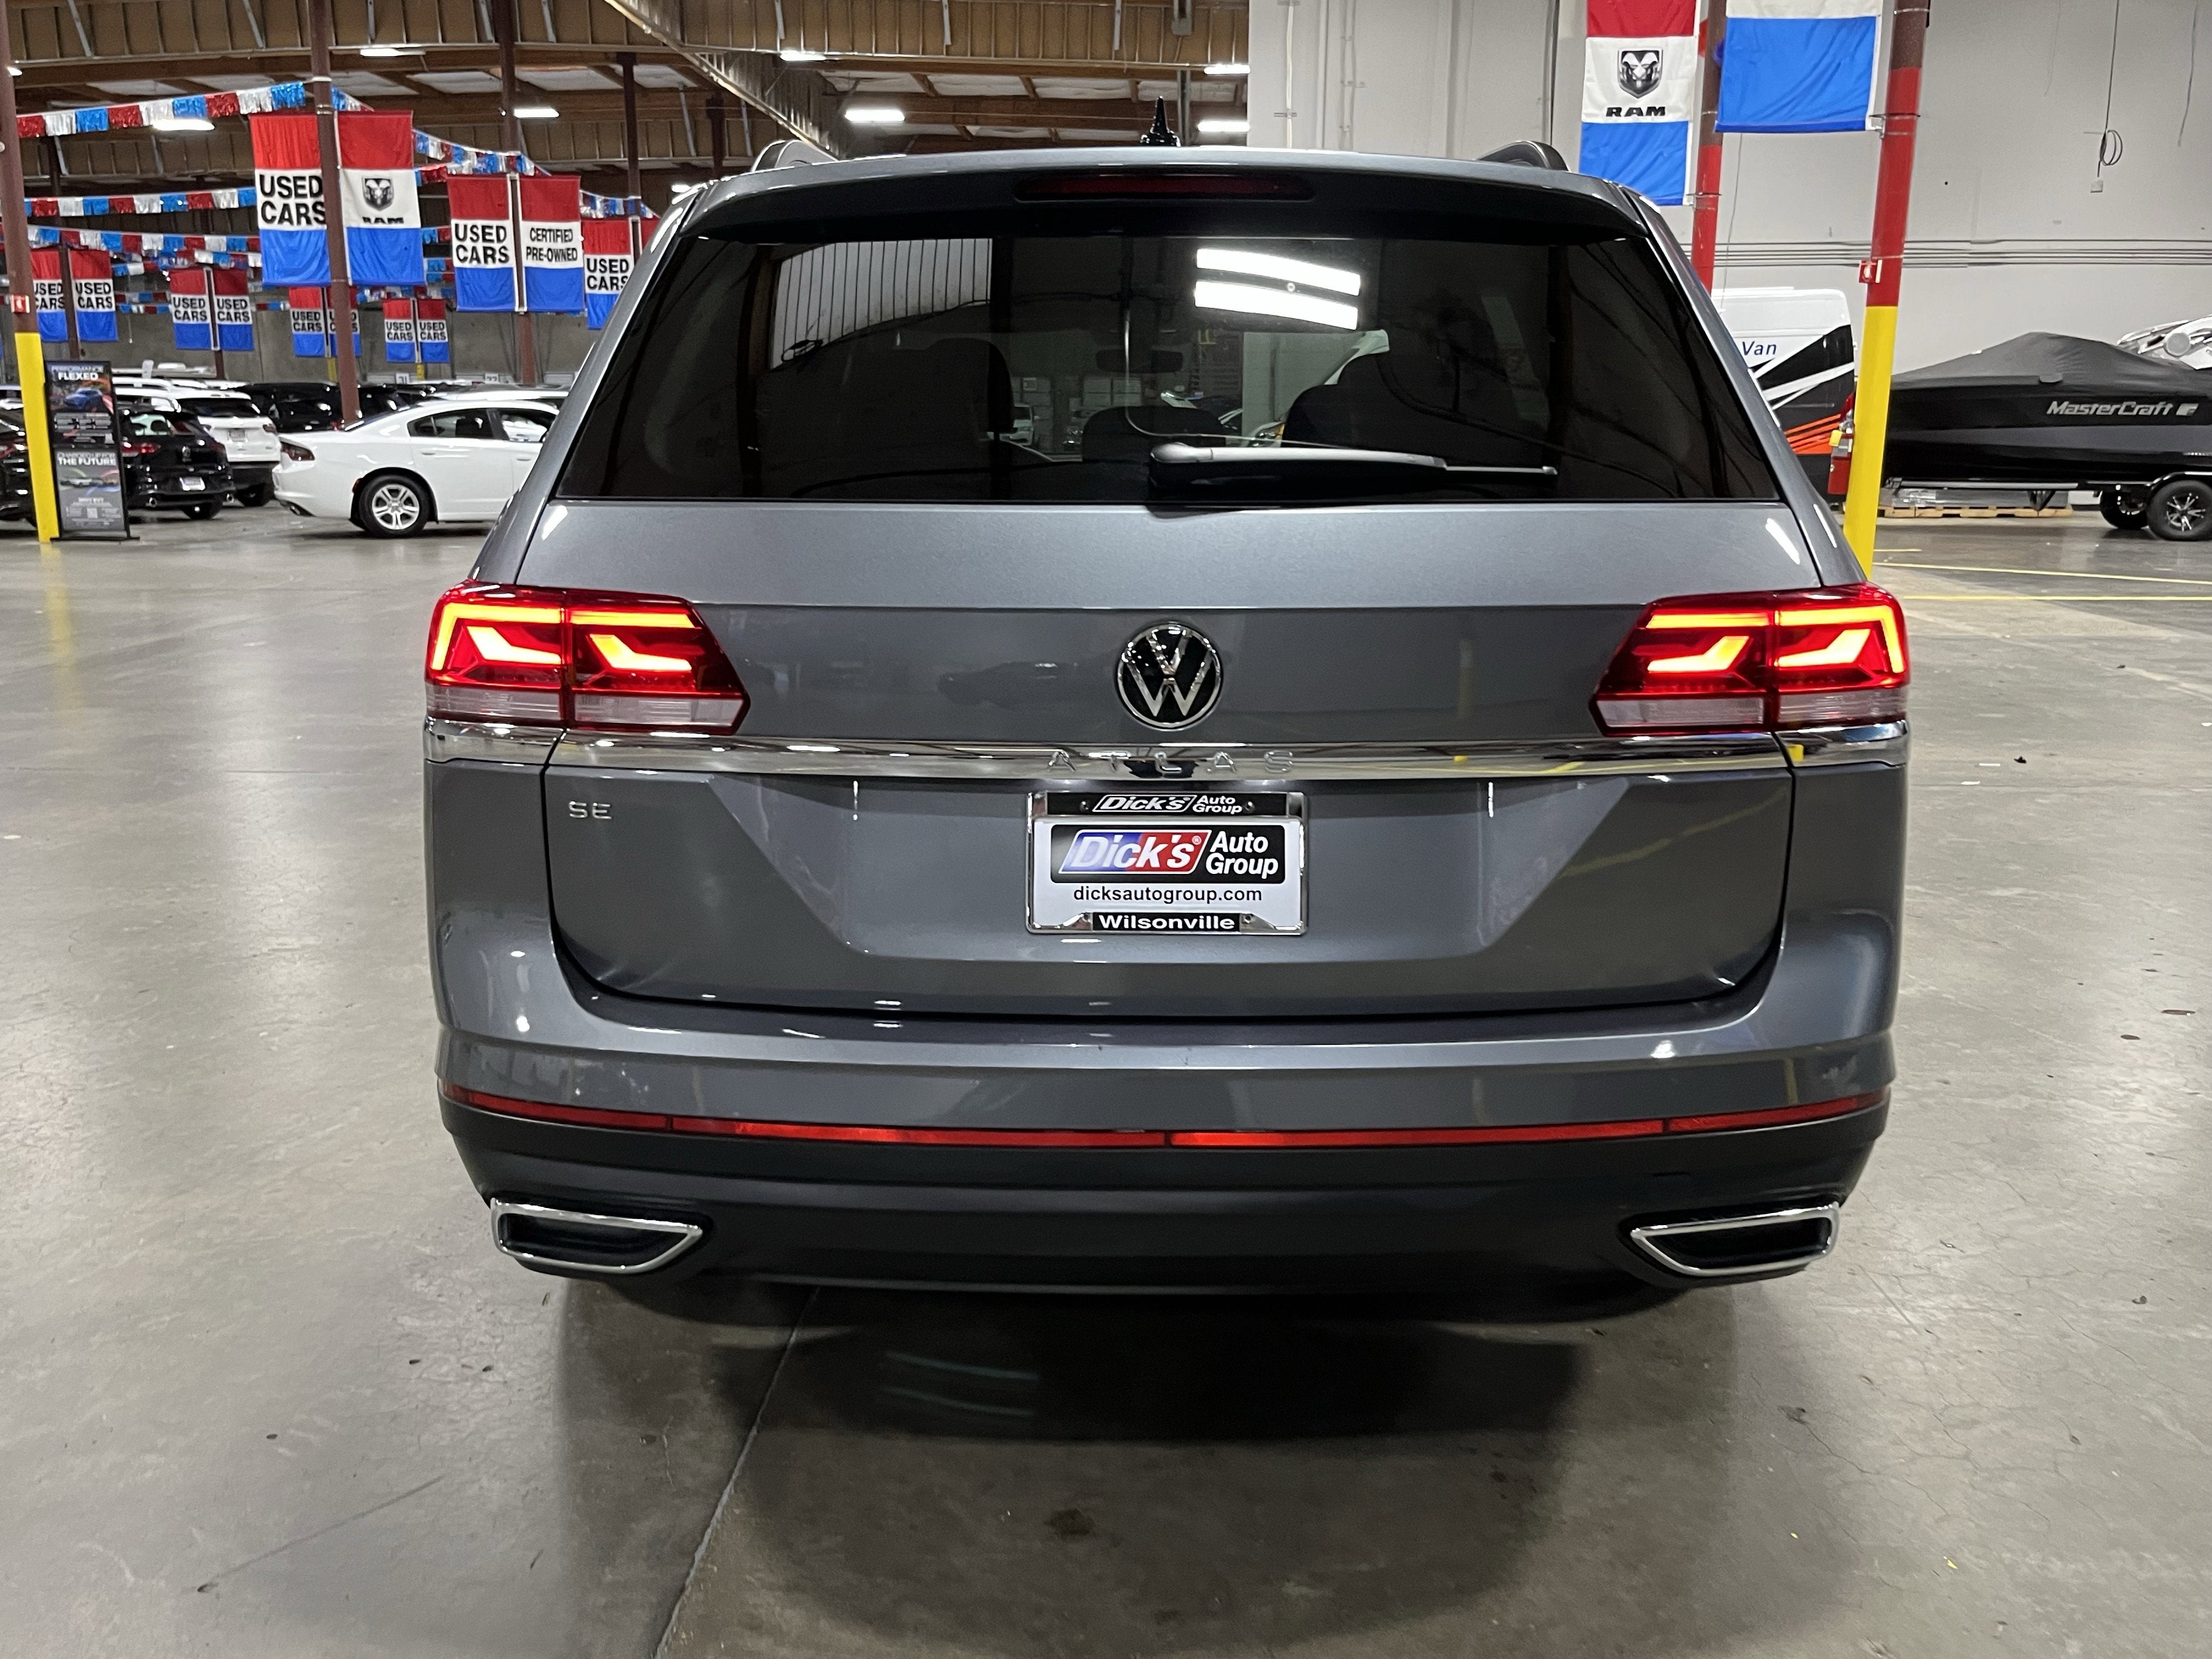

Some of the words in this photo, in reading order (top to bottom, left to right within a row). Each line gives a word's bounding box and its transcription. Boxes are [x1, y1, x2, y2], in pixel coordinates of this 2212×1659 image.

[1605, 106, 1666, 117] RAM
[259, 174, 323, 199] USED
[261, 201, 327, 225] CARS
[454, 223, 507, 244] USED
[529, 227, 573, 243] CERTIFIED
[456, 244, 510, 264] CARS
[526, 246, 578, 262] PRE-OWNED
[586, 258, 629, 274] USED
[75, 283, 111, 295] USED
[587, 275, 629, 291] CARS
[77, 297, 112, 309] CARS
[173, 297, 206, 309] USED
[216, 298, 248, 310] USED
[174, 310, 207, 321] CARS
[217, 311, 250, 322] CARS
[292, 311, 321, 321] USED
[329, 311, 357, 321] UD
[294, 323, 323, 332] CARS
[330, 323, 358, 332] CS
[386, 321, 411, 331] USED
[420, 321, 445, 331] USED
[387, 332, 413, 341] CARS
[420, 332, 447, 341] CARS
[1742, 341, 1777, 356] Van
[58, 373, 99, 381] FLEXED
[2046, 401, 2174, 415] MasterCraft
[78, 458, 116, 466] FUTURE
[1047, 751, 1294, 774] ATLAS
[1099, 796, 1185, 810] Dick's
[1197, 795, 1236, 805] Auto
[568, 800, 612, 820] SE
[1192, 804, 1243, 815] Group
[1070, 834, 1194, 868] Dick's
[1210, 831, 1269, 853] Auto
[1205, 853, 1279, 879] Group
[1074, 886, 1262, 904] dicksautogroup.com
[1098, 915, 1235, 929] Wilsonville
